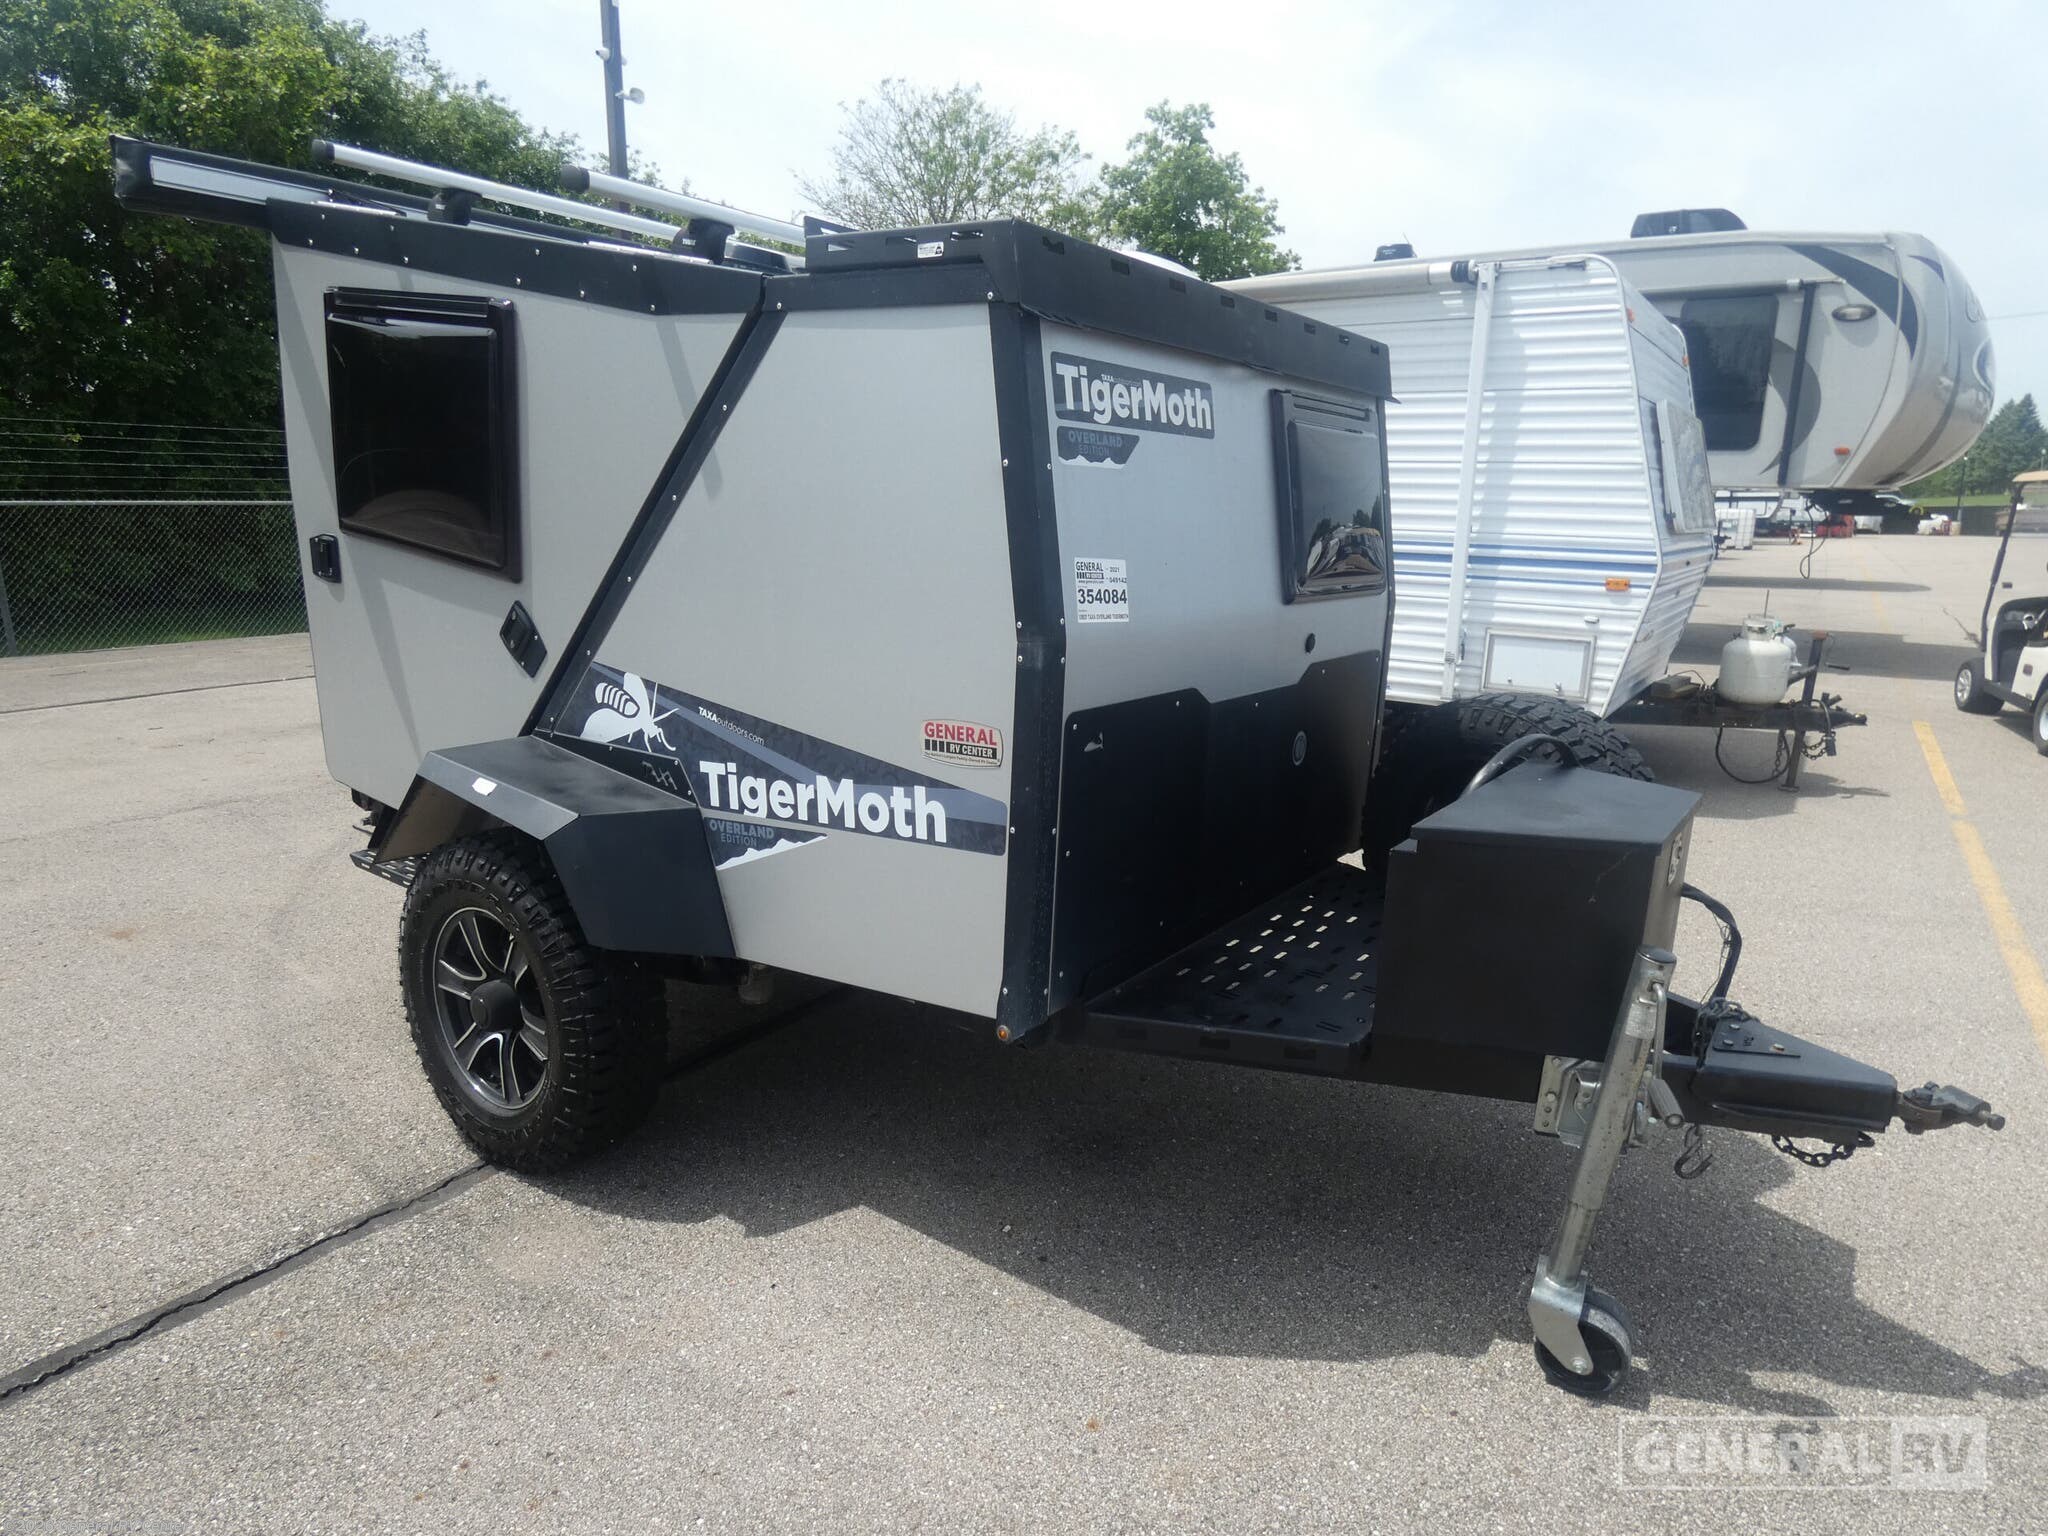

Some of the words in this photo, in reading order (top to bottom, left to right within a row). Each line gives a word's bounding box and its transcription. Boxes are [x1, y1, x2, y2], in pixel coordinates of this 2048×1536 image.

[1056, 362, 1212, 430] TigerMoth
[1068, 430, 1123, 448] OVERLAND
[1079, 445, 1110, 456] EDITION
[1075, 561, 1104, 572] GENERAL
[1078, 588, 1128, 605] 354084
[924, 721, 998, 746] GENERAL
[949, 743, 961, 754] RV
[961, 744, 993, 758] CENTER
[699, 760, 947, 843] TigerMoth
[709, 819, 775, 839] OVERLAND
[720, 832, 757, 847] EDITION
